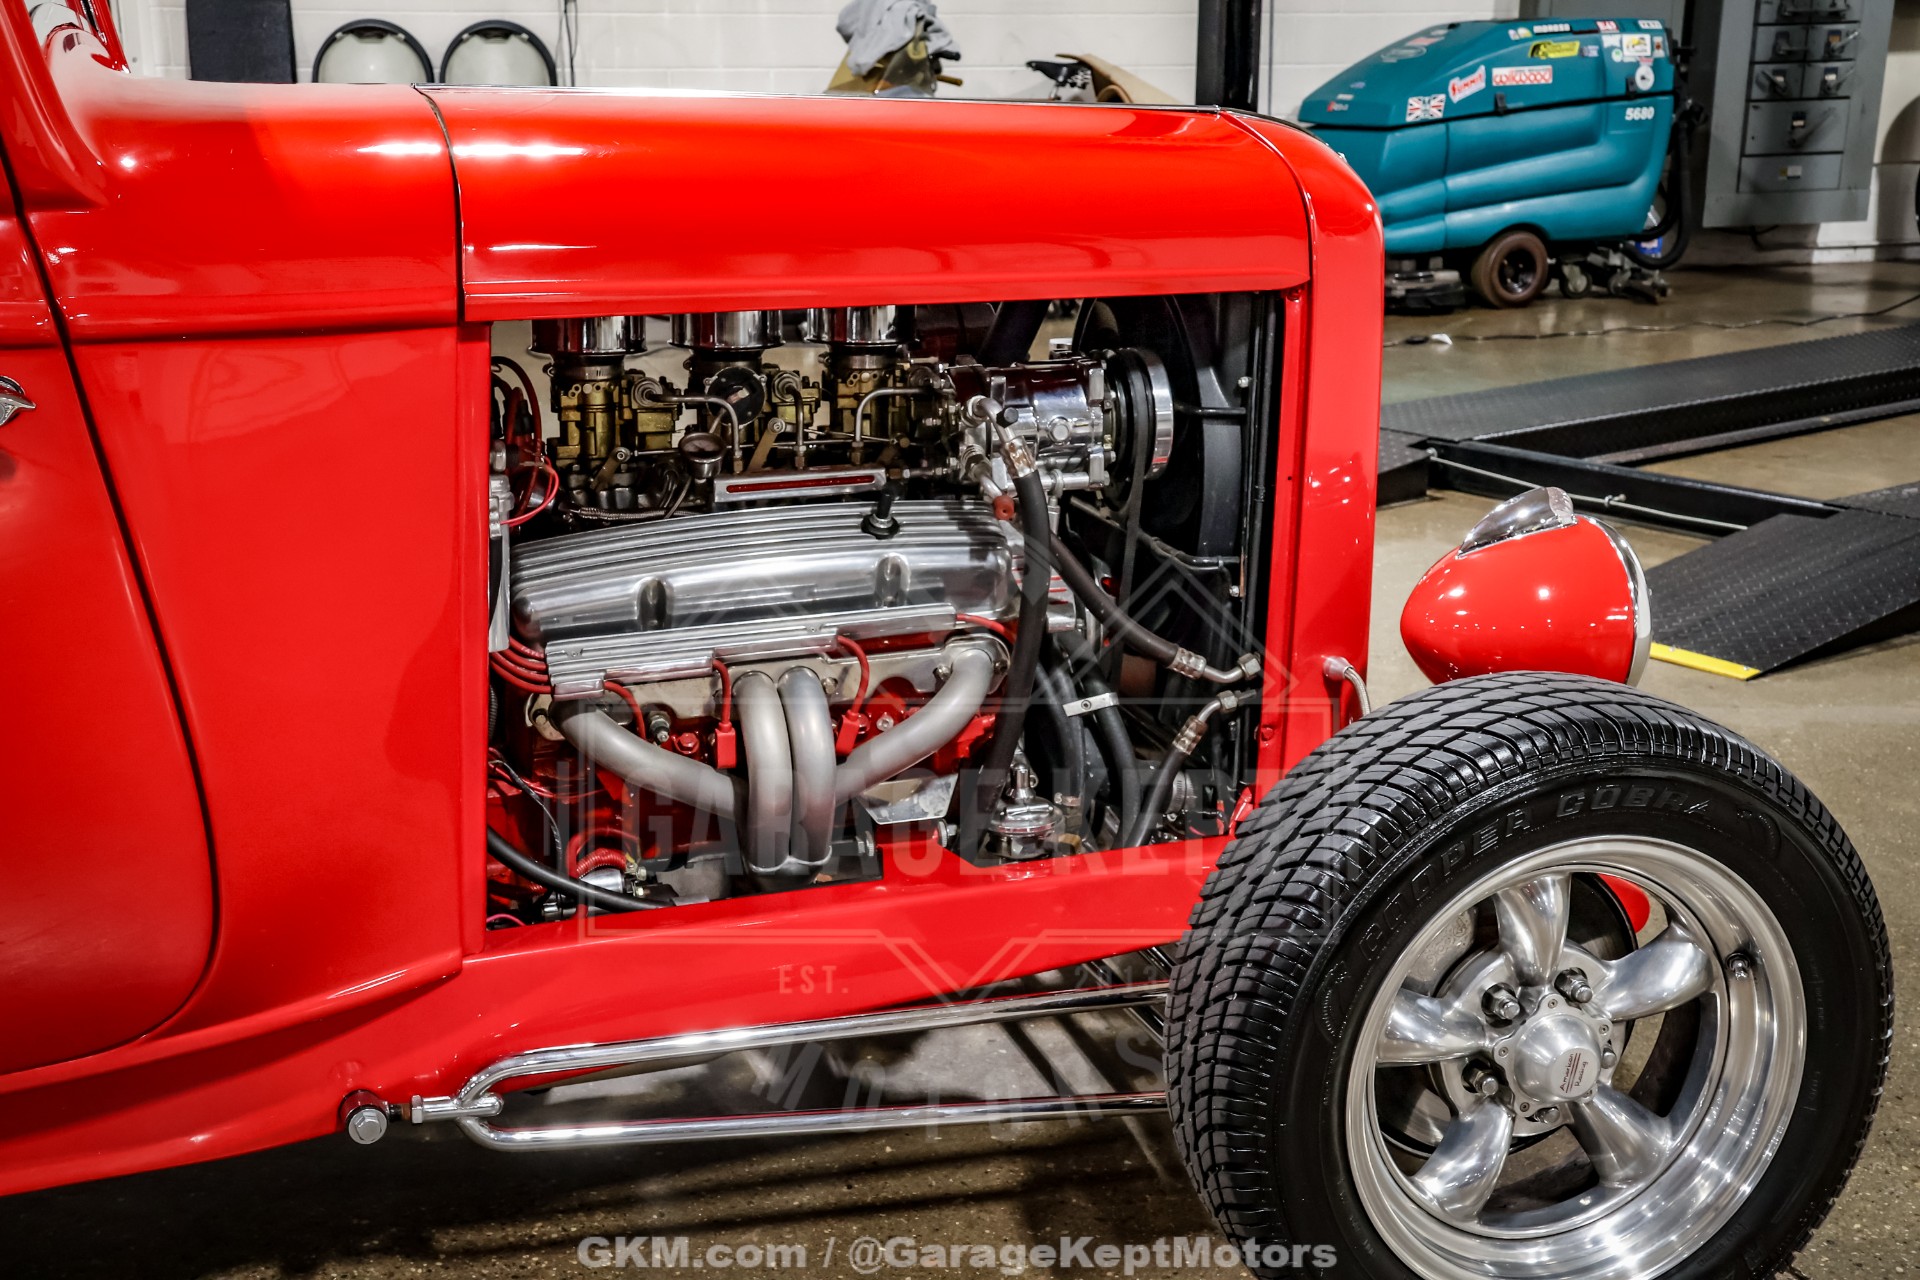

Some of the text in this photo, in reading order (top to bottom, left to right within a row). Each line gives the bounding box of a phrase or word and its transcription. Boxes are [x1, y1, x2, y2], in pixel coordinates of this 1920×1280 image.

[1625, 107, 1655, 120] 5680
[1556, 783, 1712, 818] COBRA
[1560, 1053, 1574, 1092] American
[1574, 1061, 1588, 1087] Racing
